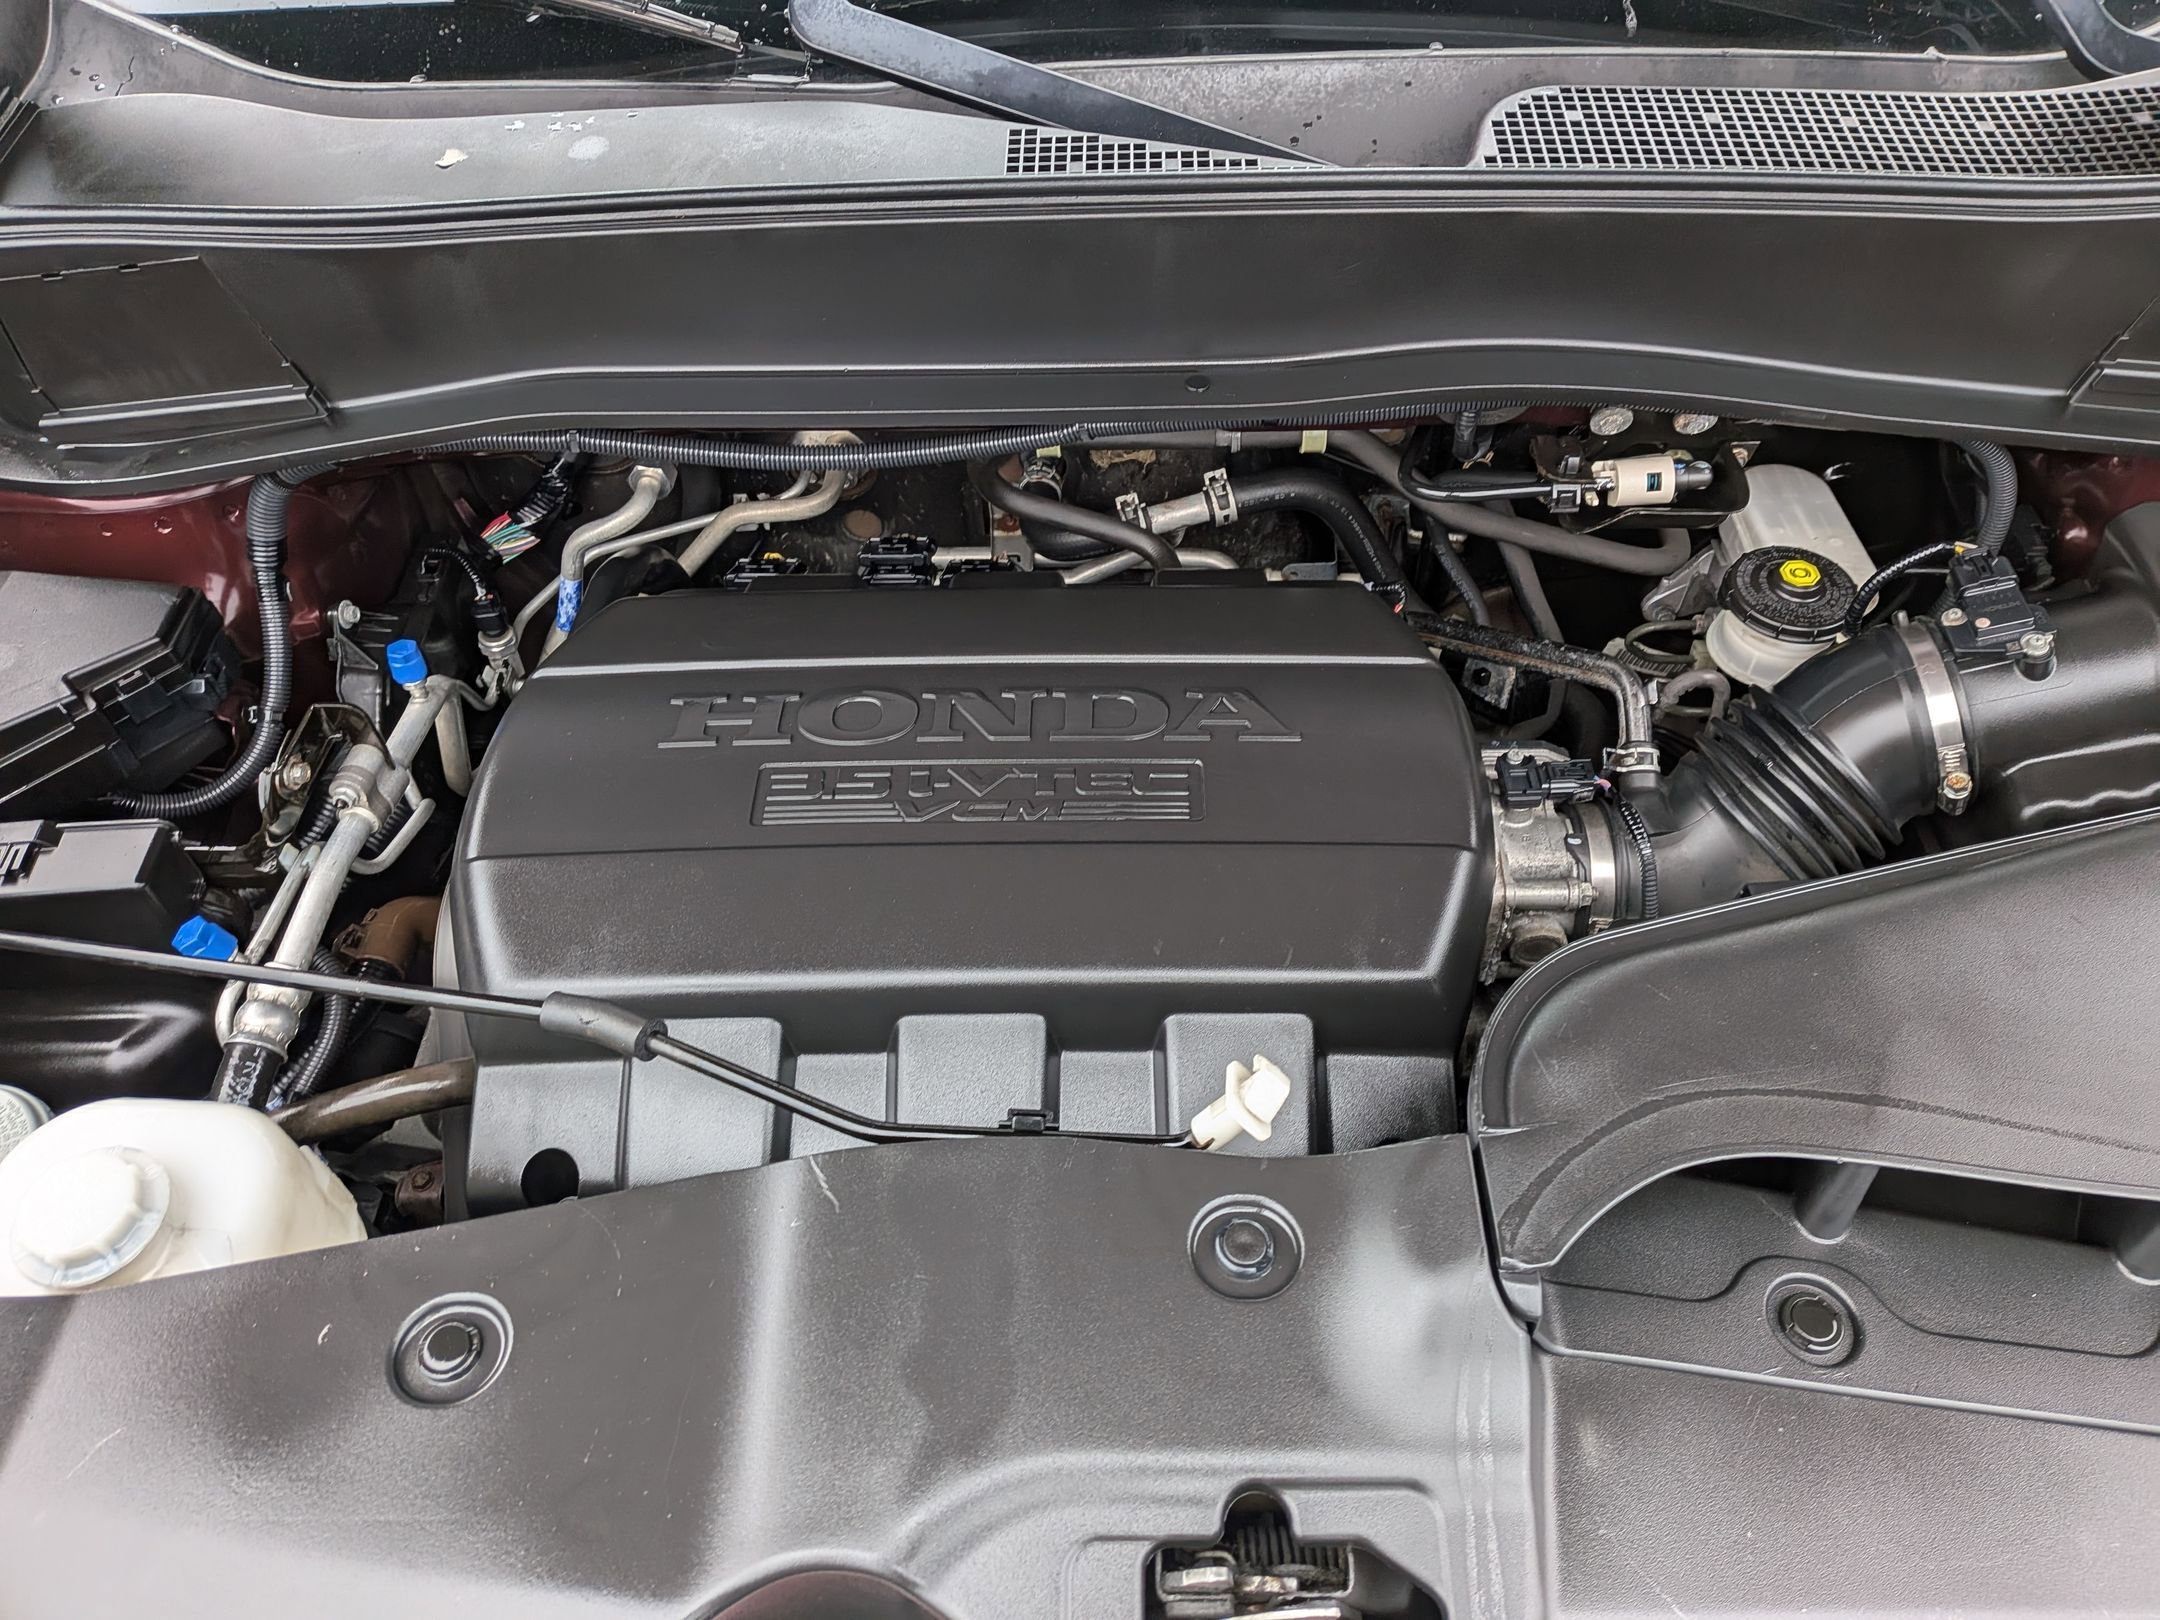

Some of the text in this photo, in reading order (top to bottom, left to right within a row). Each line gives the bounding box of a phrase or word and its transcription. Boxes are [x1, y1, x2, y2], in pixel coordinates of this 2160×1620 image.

[657, 687, 1302, 748] HONDA
[766, 766, 892, 801] 3.5
[893, 800, 1064, 823] VCM
